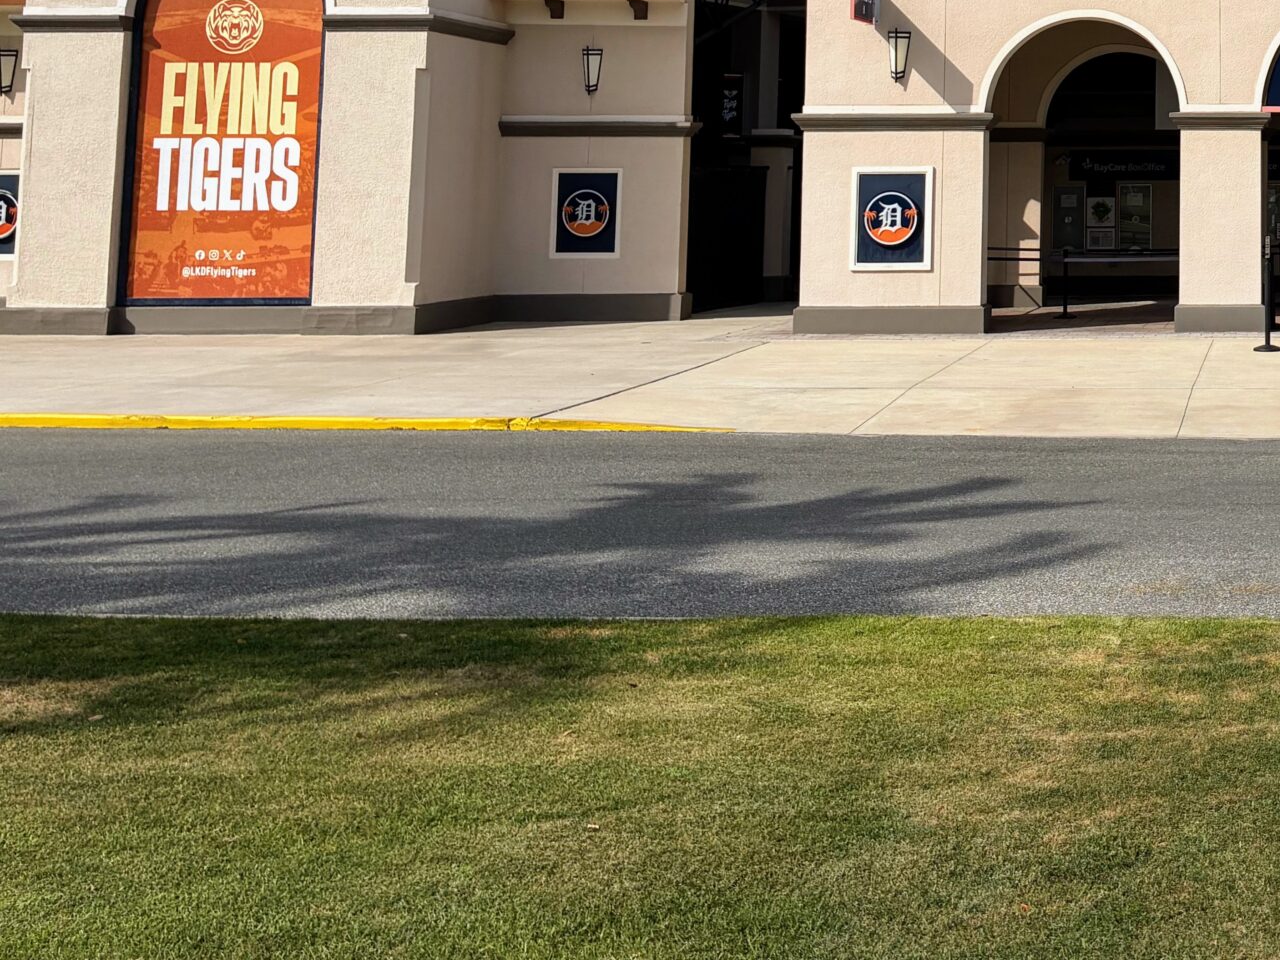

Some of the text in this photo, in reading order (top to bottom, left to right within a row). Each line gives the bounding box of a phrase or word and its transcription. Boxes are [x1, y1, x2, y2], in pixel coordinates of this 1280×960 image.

[159, 61, 300, 135] FLYING
[152, 136, 301, 212] TIGERS
[181, 266, 257, 279] @LKDFlyingTigers
